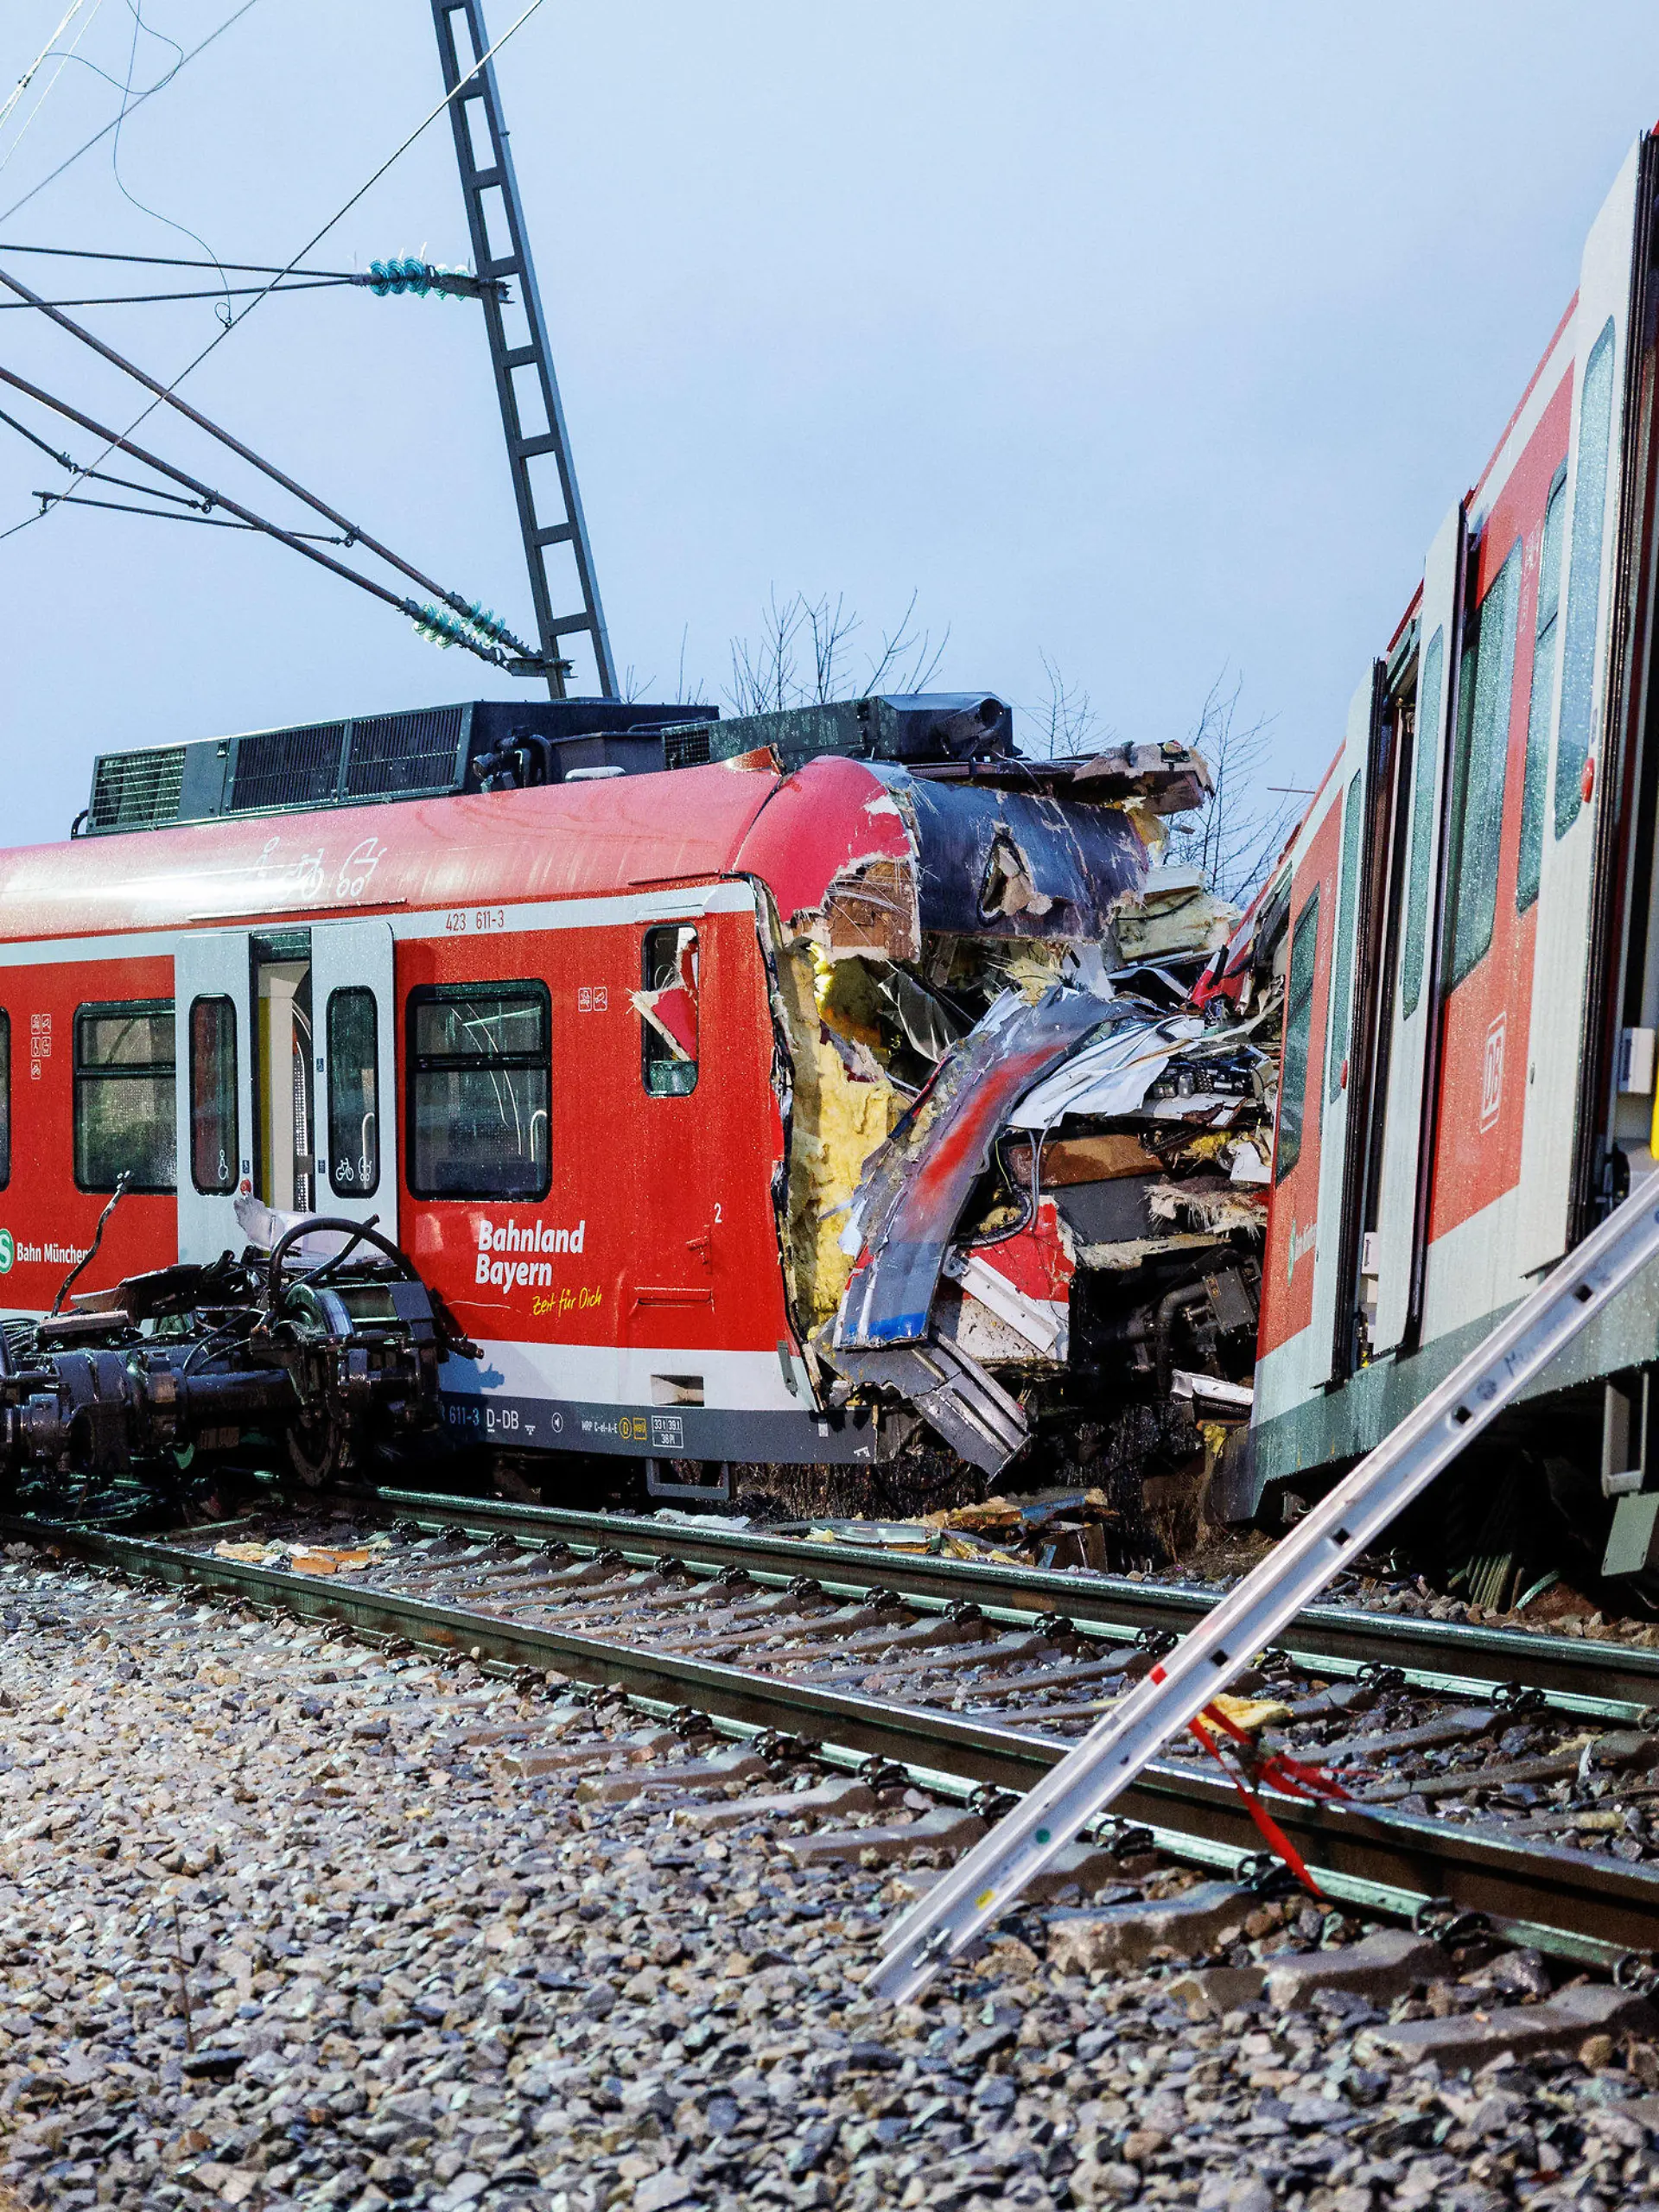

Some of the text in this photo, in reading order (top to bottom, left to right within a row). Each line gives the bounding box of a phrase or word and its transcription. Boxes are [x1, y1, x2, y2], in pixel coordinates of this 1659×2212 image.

[445, 909, 505, 931] 423 611-3
[1481, 1025, 1505, 1121] DB
[714, 1202, 723, 1224] 2
[478, 1218, 586, 1254] Bahnland
[16, 1243, 42, 1262] Bahn
[475, 1253, 553, 1294] Bayern
[531, 1285, 603, 1318] Zeit für Dich
[448, 1405, 480, 1426] 611-3
[486, 1408, 519, 1431] D-DB
